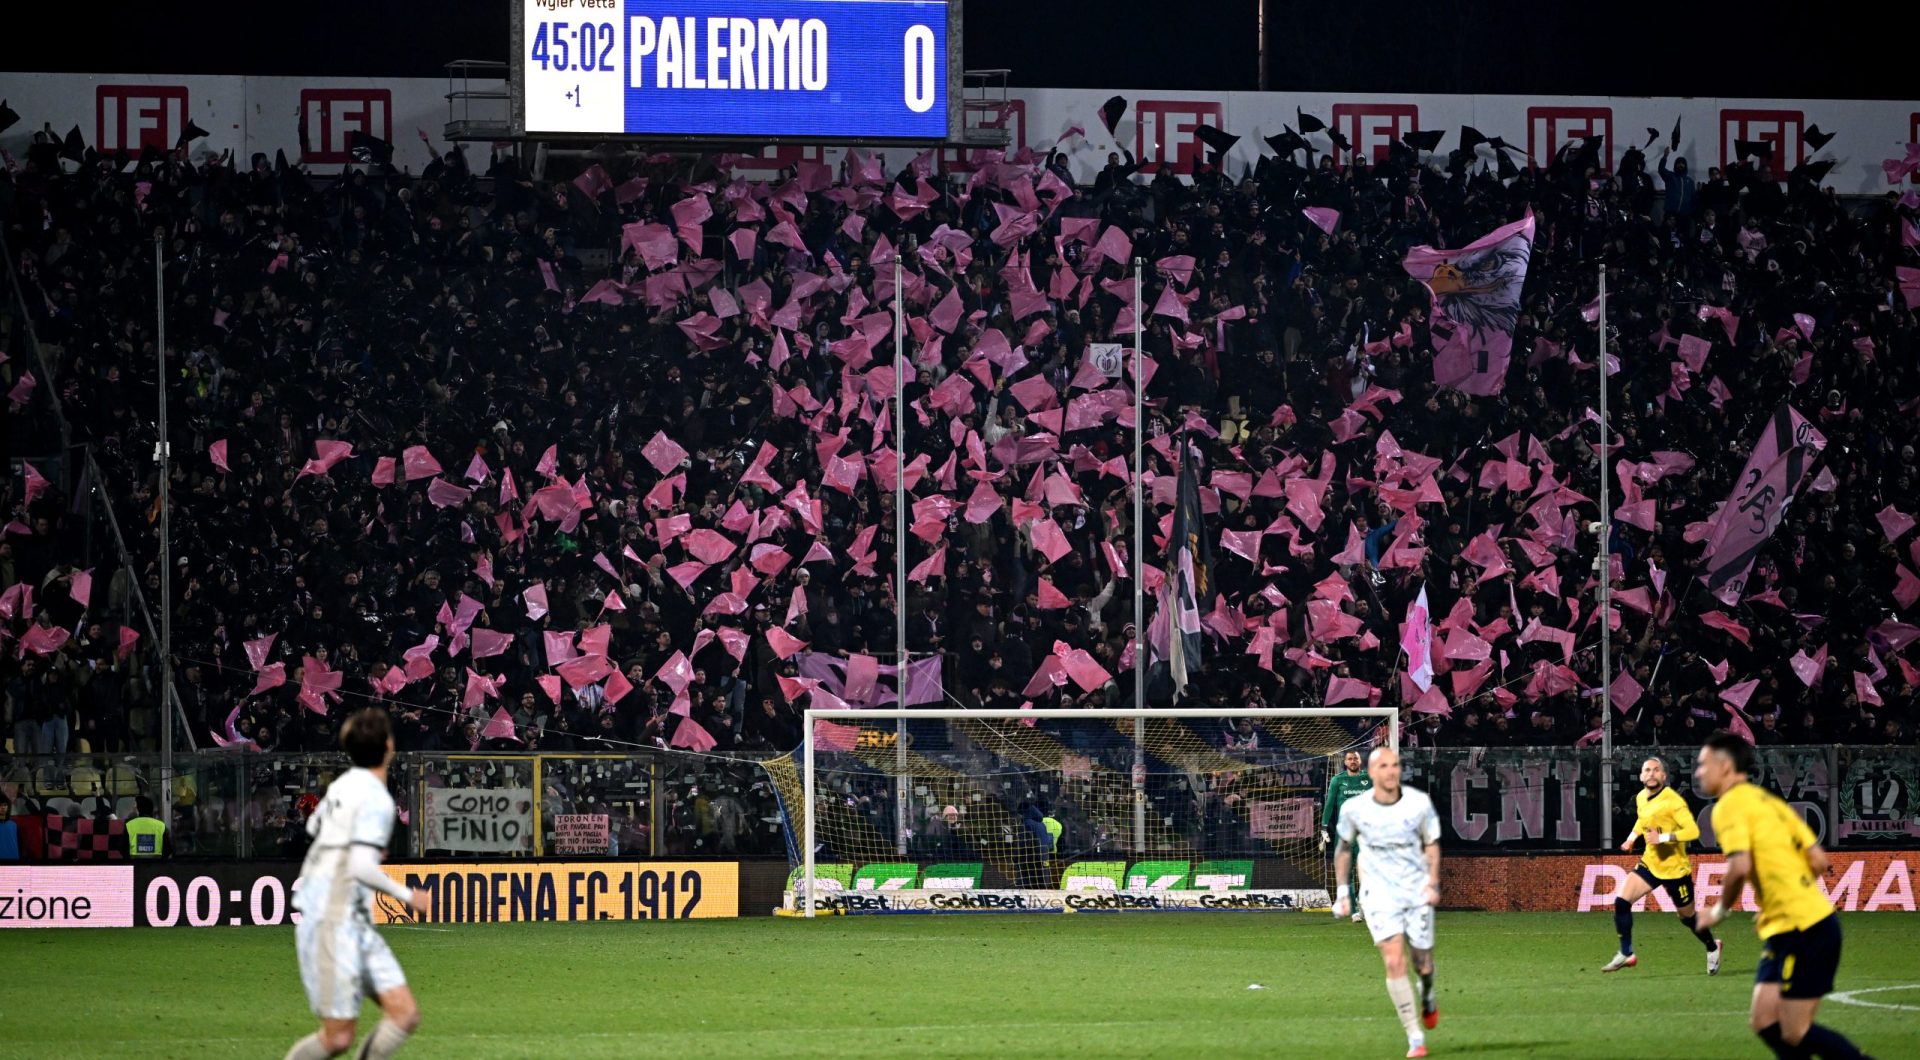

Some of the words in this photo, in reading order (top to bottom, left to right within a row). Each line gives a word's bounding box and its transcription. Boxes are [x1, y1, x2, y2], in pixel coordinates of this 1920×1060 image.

[532, 22, 614, 71] 45:02
[630, 16, 827, 91] PALERMO
[904, 25, 934, 112] 0
[565, 85, 581, 107] +1
[103, 96, 181, 149] IFI
[307, 100, 385, 152] IFI
[447, 794, 510, 814] COMO
[1451, 759, 1581, 841] CNI
[1857, 779, 1899, 815] 12
[557, 815, 604, 824] JORONEN
[0, 888, 91, 920] zione
[406, 871, 557, 923] MODENA
[568, 872, 608, 921] FC
[619, 870, 702, 920] 1912
[929, 893, 1026, 909] GoldBet
[1065, 894, 1161, 909] GoldBet
